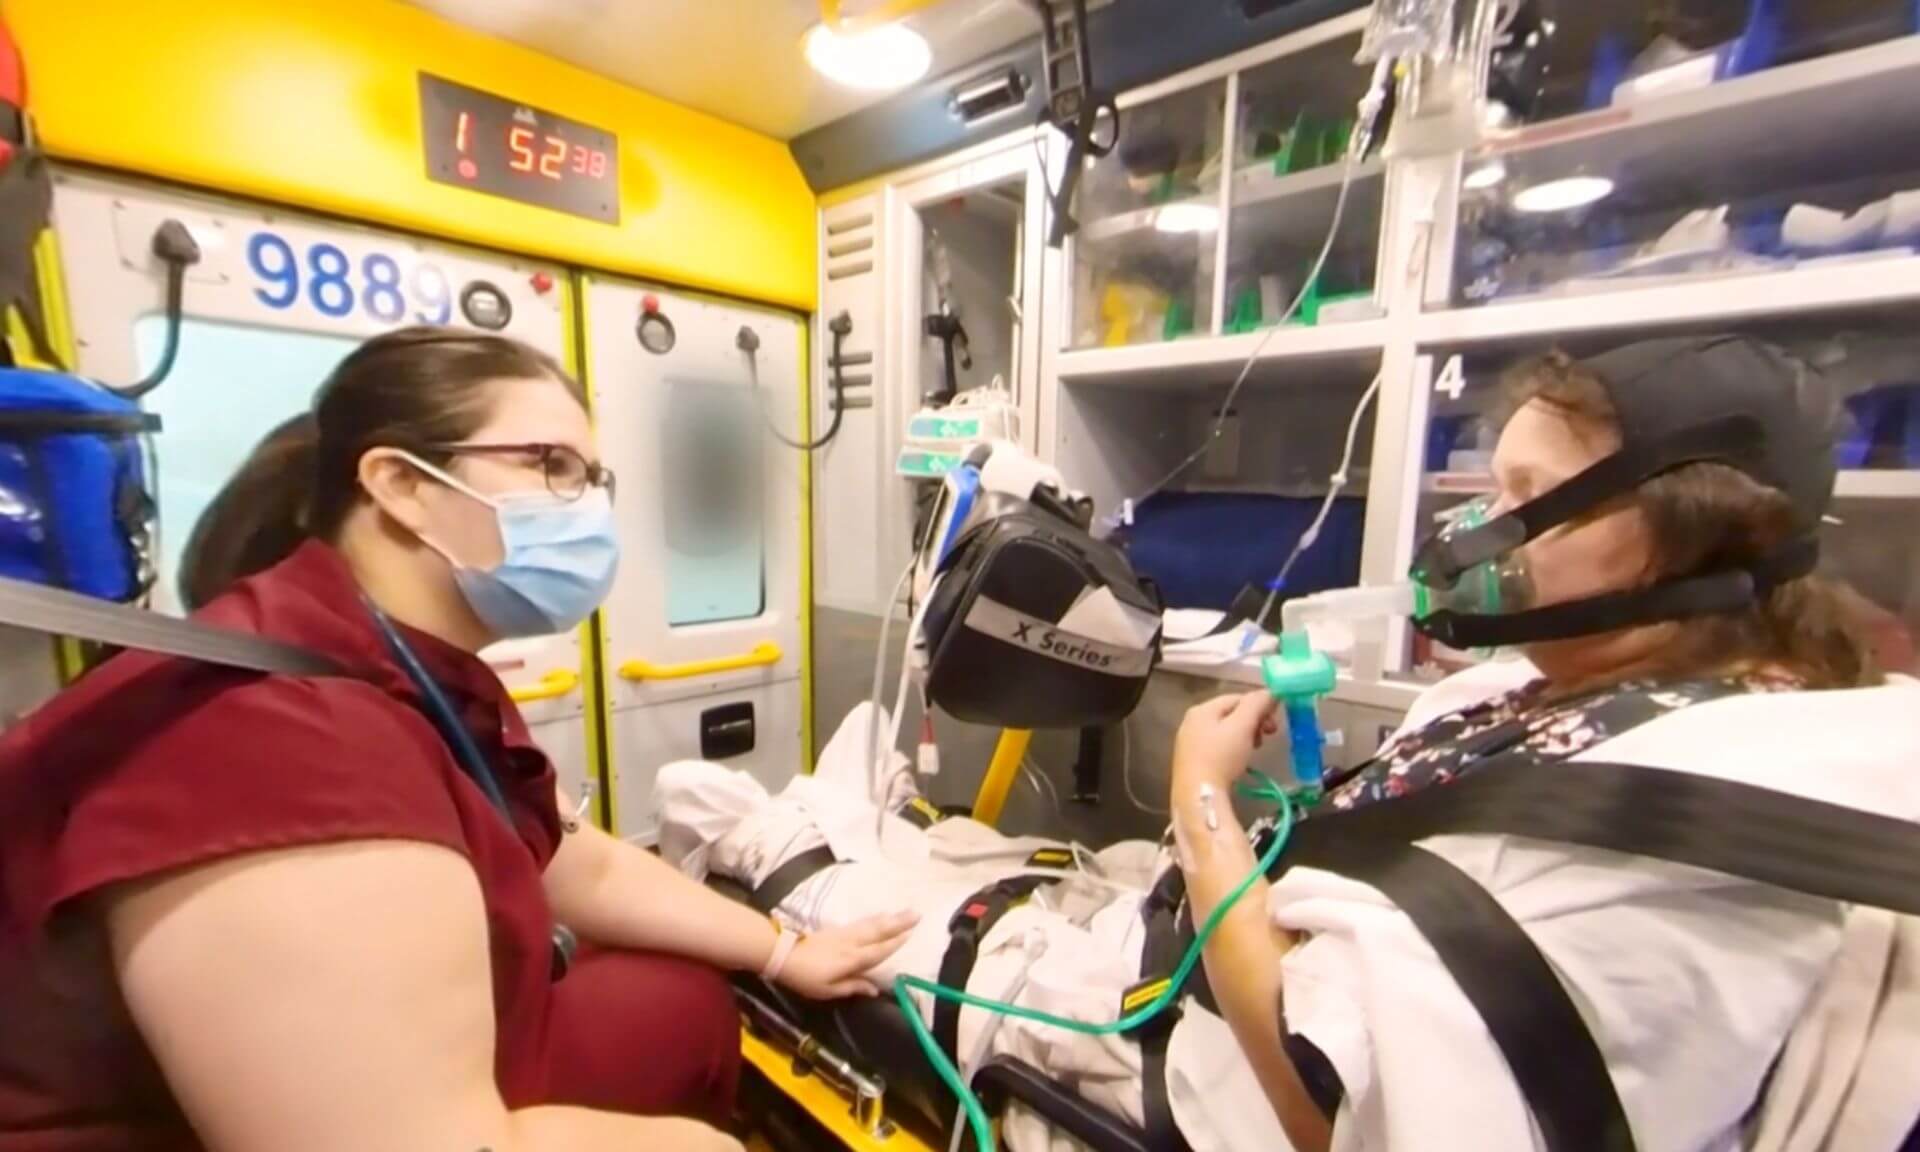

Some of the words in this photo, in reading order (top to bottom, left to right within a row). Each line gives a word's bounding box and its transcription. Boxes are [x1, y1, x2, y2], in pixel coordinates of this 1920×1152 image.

[509, 126, 567, 180] 52
[247, 232, 452, 326] 9889
[1434, 353, 1467, 400] 4
[1011, 621, 1032, 643] X
[1039, 630, 1111, 667] Series
